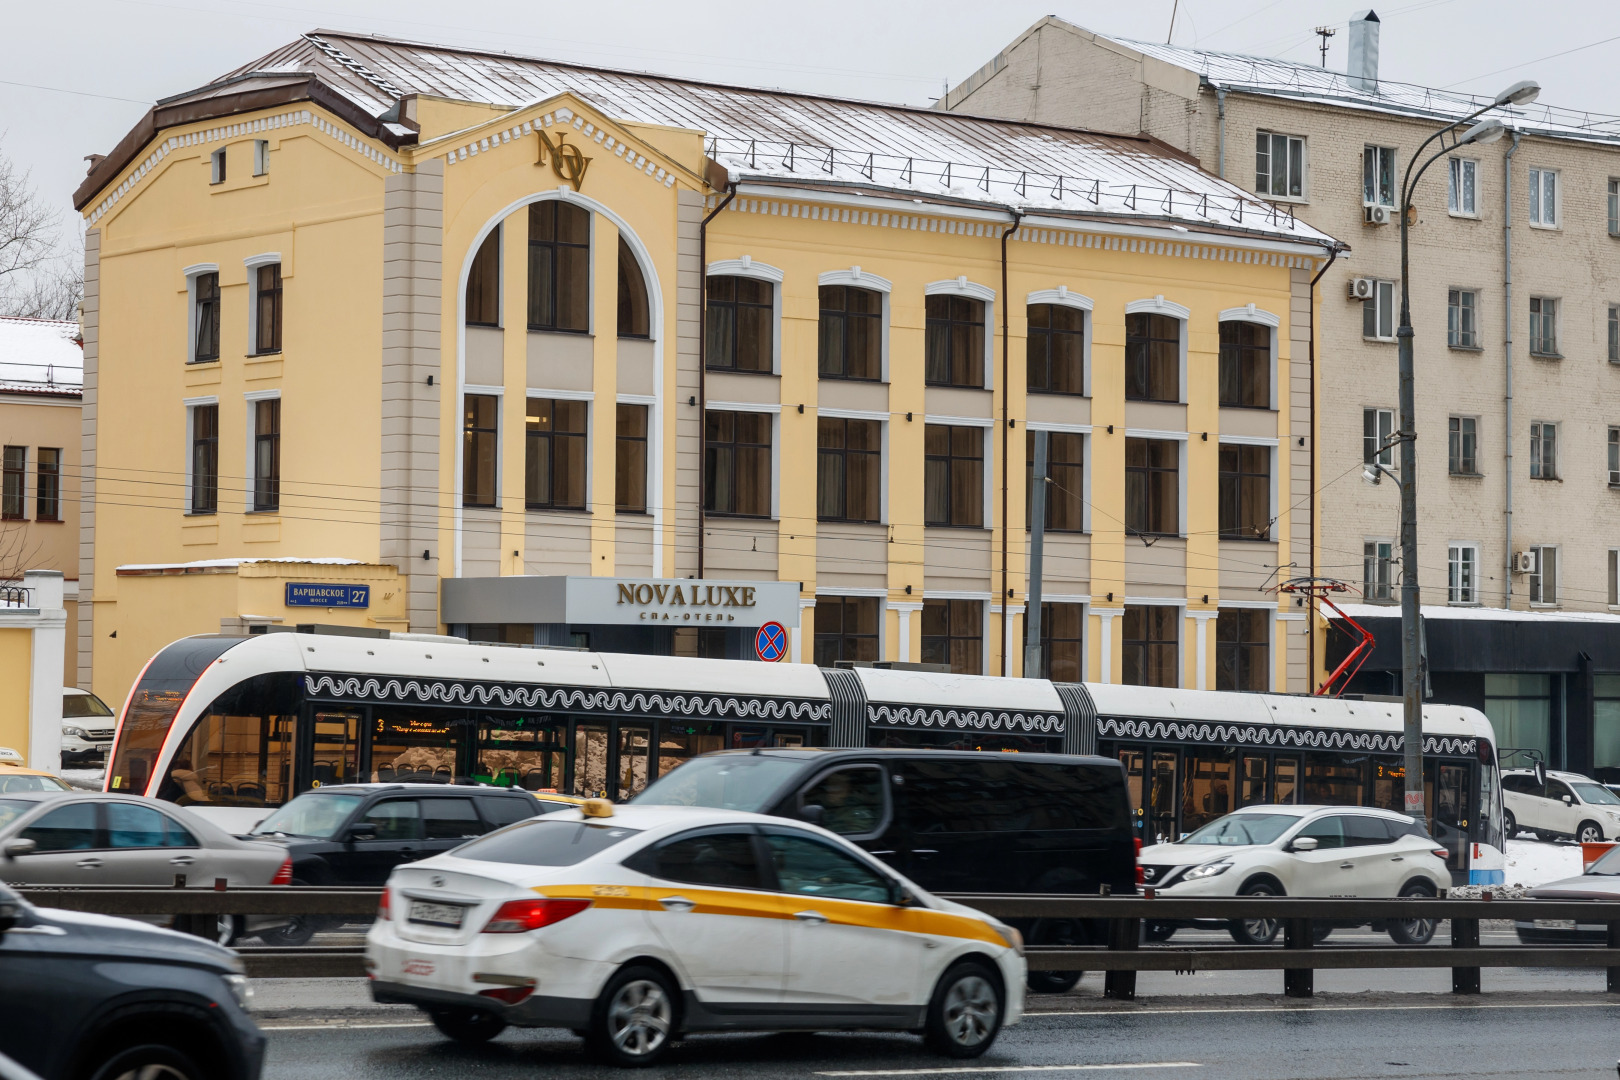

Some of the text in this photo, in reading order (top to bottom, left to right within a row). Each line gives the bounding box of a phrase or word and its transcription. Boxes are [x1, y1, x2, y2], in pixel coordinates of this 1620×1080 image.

[293, 587, 345, 597] ВАРШАВСКОЕ
[352, 590, 366, 603] 27
[617, 583, 757, 607] NOVA LUXE
[639, 612, 735, 621] СПА-ОТЕЛЬ
[376, 718, 385, 732] 3
[1378, 765, 1383, 776] 3
